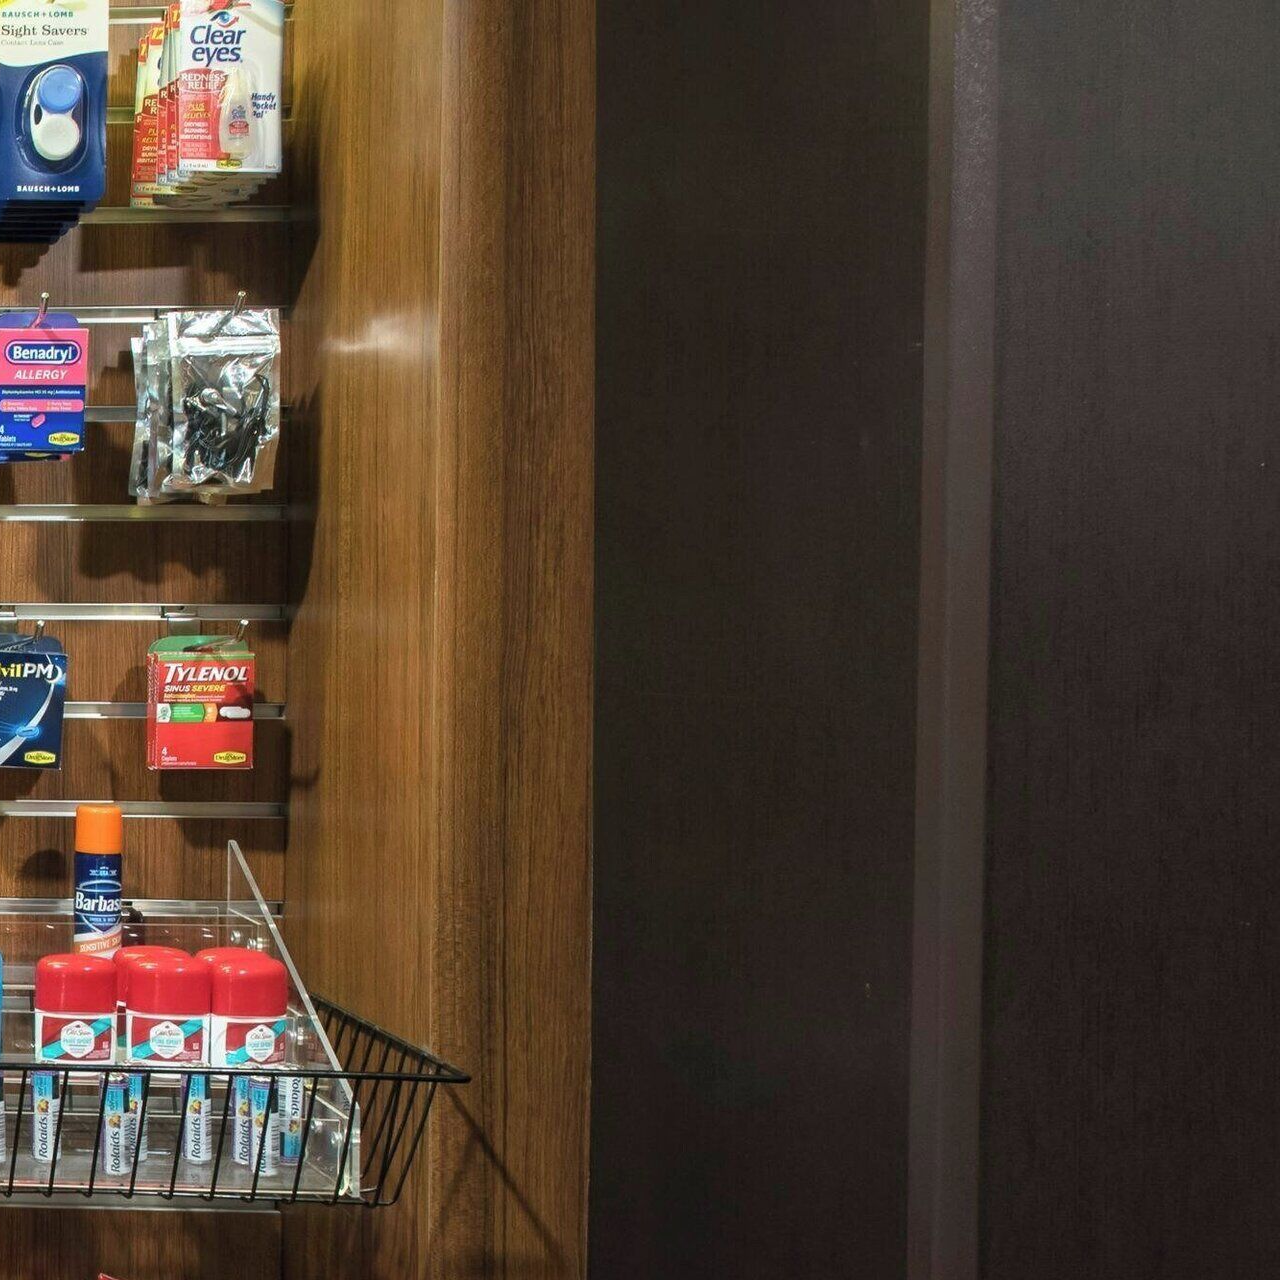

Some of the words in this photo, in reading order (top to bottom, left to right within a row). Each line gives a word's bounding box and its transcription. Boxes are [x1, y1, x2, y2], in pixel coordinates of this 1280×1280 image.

[0, 24, 38, 38] Sight
[41, 25, 87, 36] Savers
[190, 26, 246, 45] Clear
[180, 73, 226, 82] REDNESS
[251, 92, 276, 102] Handy
[12, 345, 73, 364] Benadryl
[13, 370, 68, 380] ALLERGY
[22, 662, 53, 679] PM
[164, 662, 248, 683] TYLENOL
[163, 684, 191, 693] SINUS
[191, 684, 227, 693] SEVERE
[74, 890, 122, 912] Barbas
[39, 1115, 49, 1160] Rolaids
[191, 1116, 201, 1160] Rolaids
[110, 1131, 121, 1174] Rolaids
